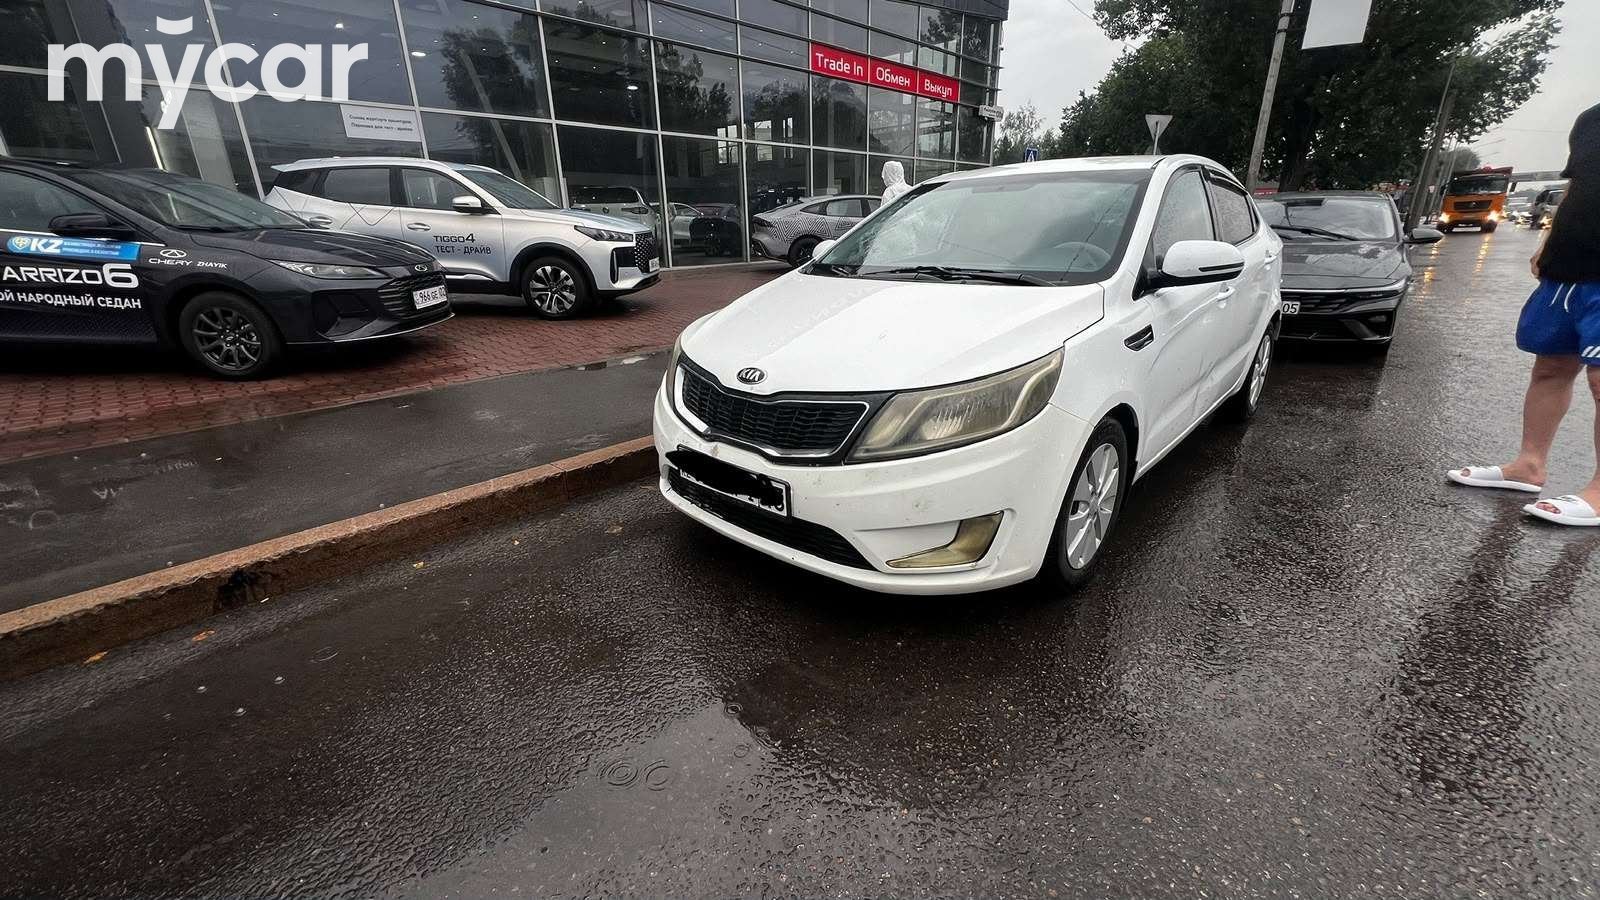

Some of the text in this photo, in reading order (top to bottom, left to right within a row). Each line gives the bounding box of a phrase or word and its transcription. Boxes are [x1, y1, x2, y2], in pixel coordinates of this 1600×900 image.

[815, 52, 865, 77] Trade In
[876, 66, 911, 87] Обмен
[924, 78, 953, 98] Выкуп
[433, 233, 476, 243] TIGGO4
[30, 238, 63, 253] KZ
[435, 245, 455, 254] ТЕСТ
[463, 245, 492, 255] ДРАЙВ
[148, 258, 193, 266] CHERY
[17, 292, 95, 307] НАРОДНЫЙ
[97, 296, 142, 310] СЕДАН
[1282, 303, 1298, 314] 05
[739, 369, 761, 382] KIA
